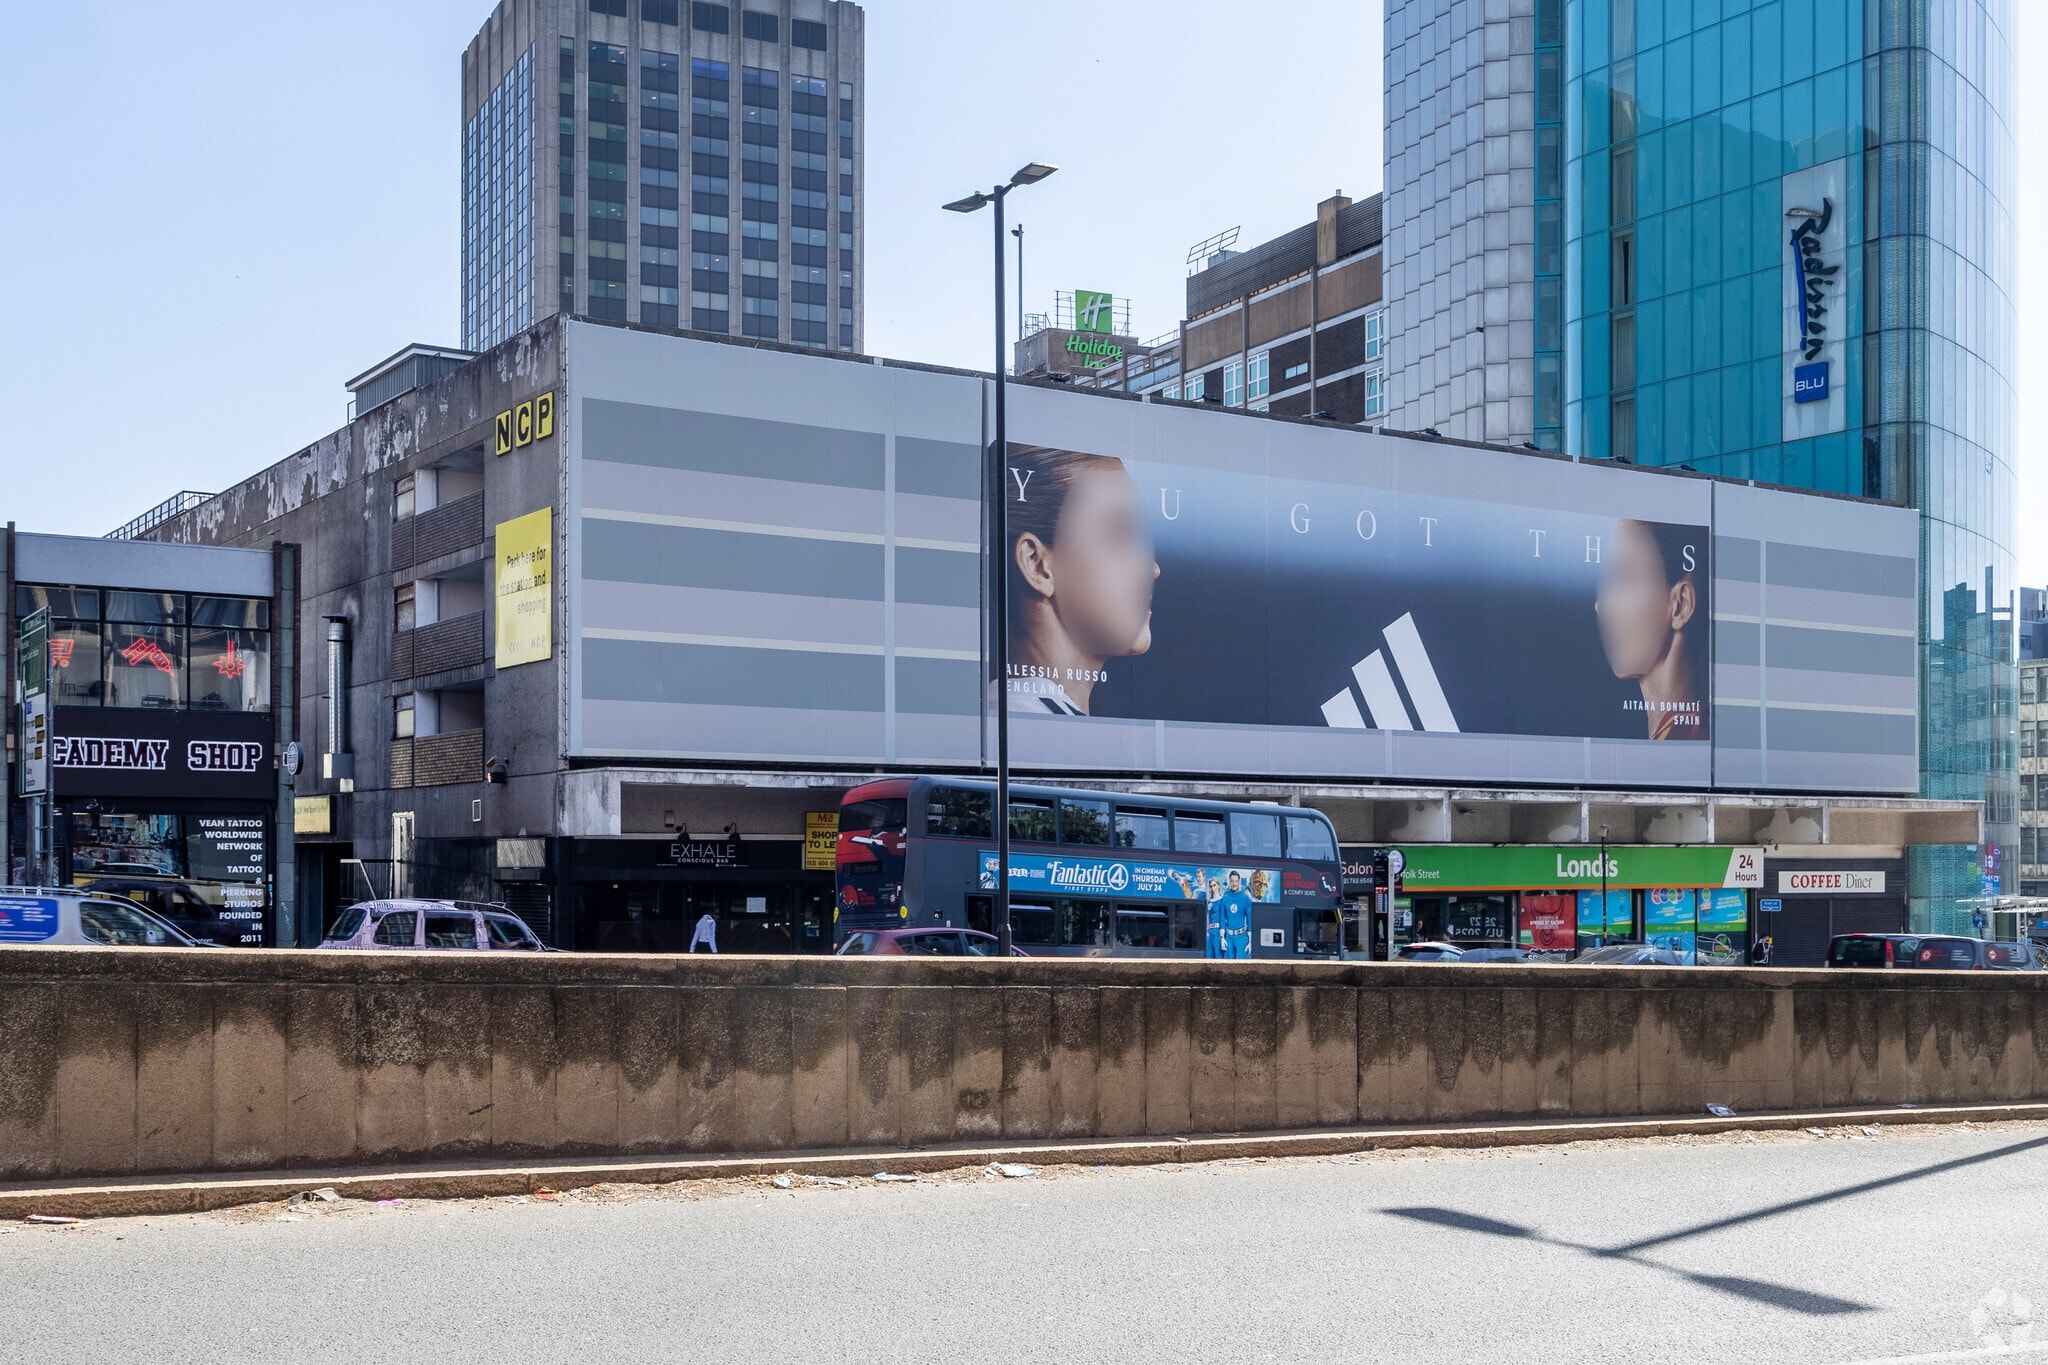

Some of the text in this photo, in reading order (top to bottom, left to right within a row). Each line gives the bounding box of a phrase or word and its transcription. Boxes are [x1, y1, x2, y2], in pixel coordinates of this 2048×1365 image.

[1785, 197, 1840, 361] Radisson
[1066, 334, 1123, 360] Holiday
[1084, 354, 1108, 368] Inn
[1796, 378, 1824, 391] BLU
[497, 396, 552, 452] NCP
[506, 546, 546, 569] Park here for
[510, 576, 532, 593] station
[534, 570, 546, 586] and
[518, 598, 546, 616] shopping
[1006, 663, 1108, 682] ALESSIA RUSSO
[1007, 681, 1064, 695] ENGLAND
[1623, 700, 1700, 712] AITANA BONMATÍ
[1674, 715, 1700, 726] SPAIN
[52, 736, 170, 770] CADEMY
[188, 740, 263, 772] SHOP
[199, 820, 263, 828] VEAN TATTOO
[812, 830, 837, 839] SHOP
[670, 843, 736, 858] EXHALE
[1739, 854, 1753, 869] 24
[1050, 861, 1109, 885] Fantastic
[1109, 864, 1126, 889] 4
[1132, 874, 1168, 883] THURSDAY
[1418, 869, 1440, 879] Street
[1735, 872, 1757, 882] Hours
[1790, 874, 1873, 888] COFFEE Diner
